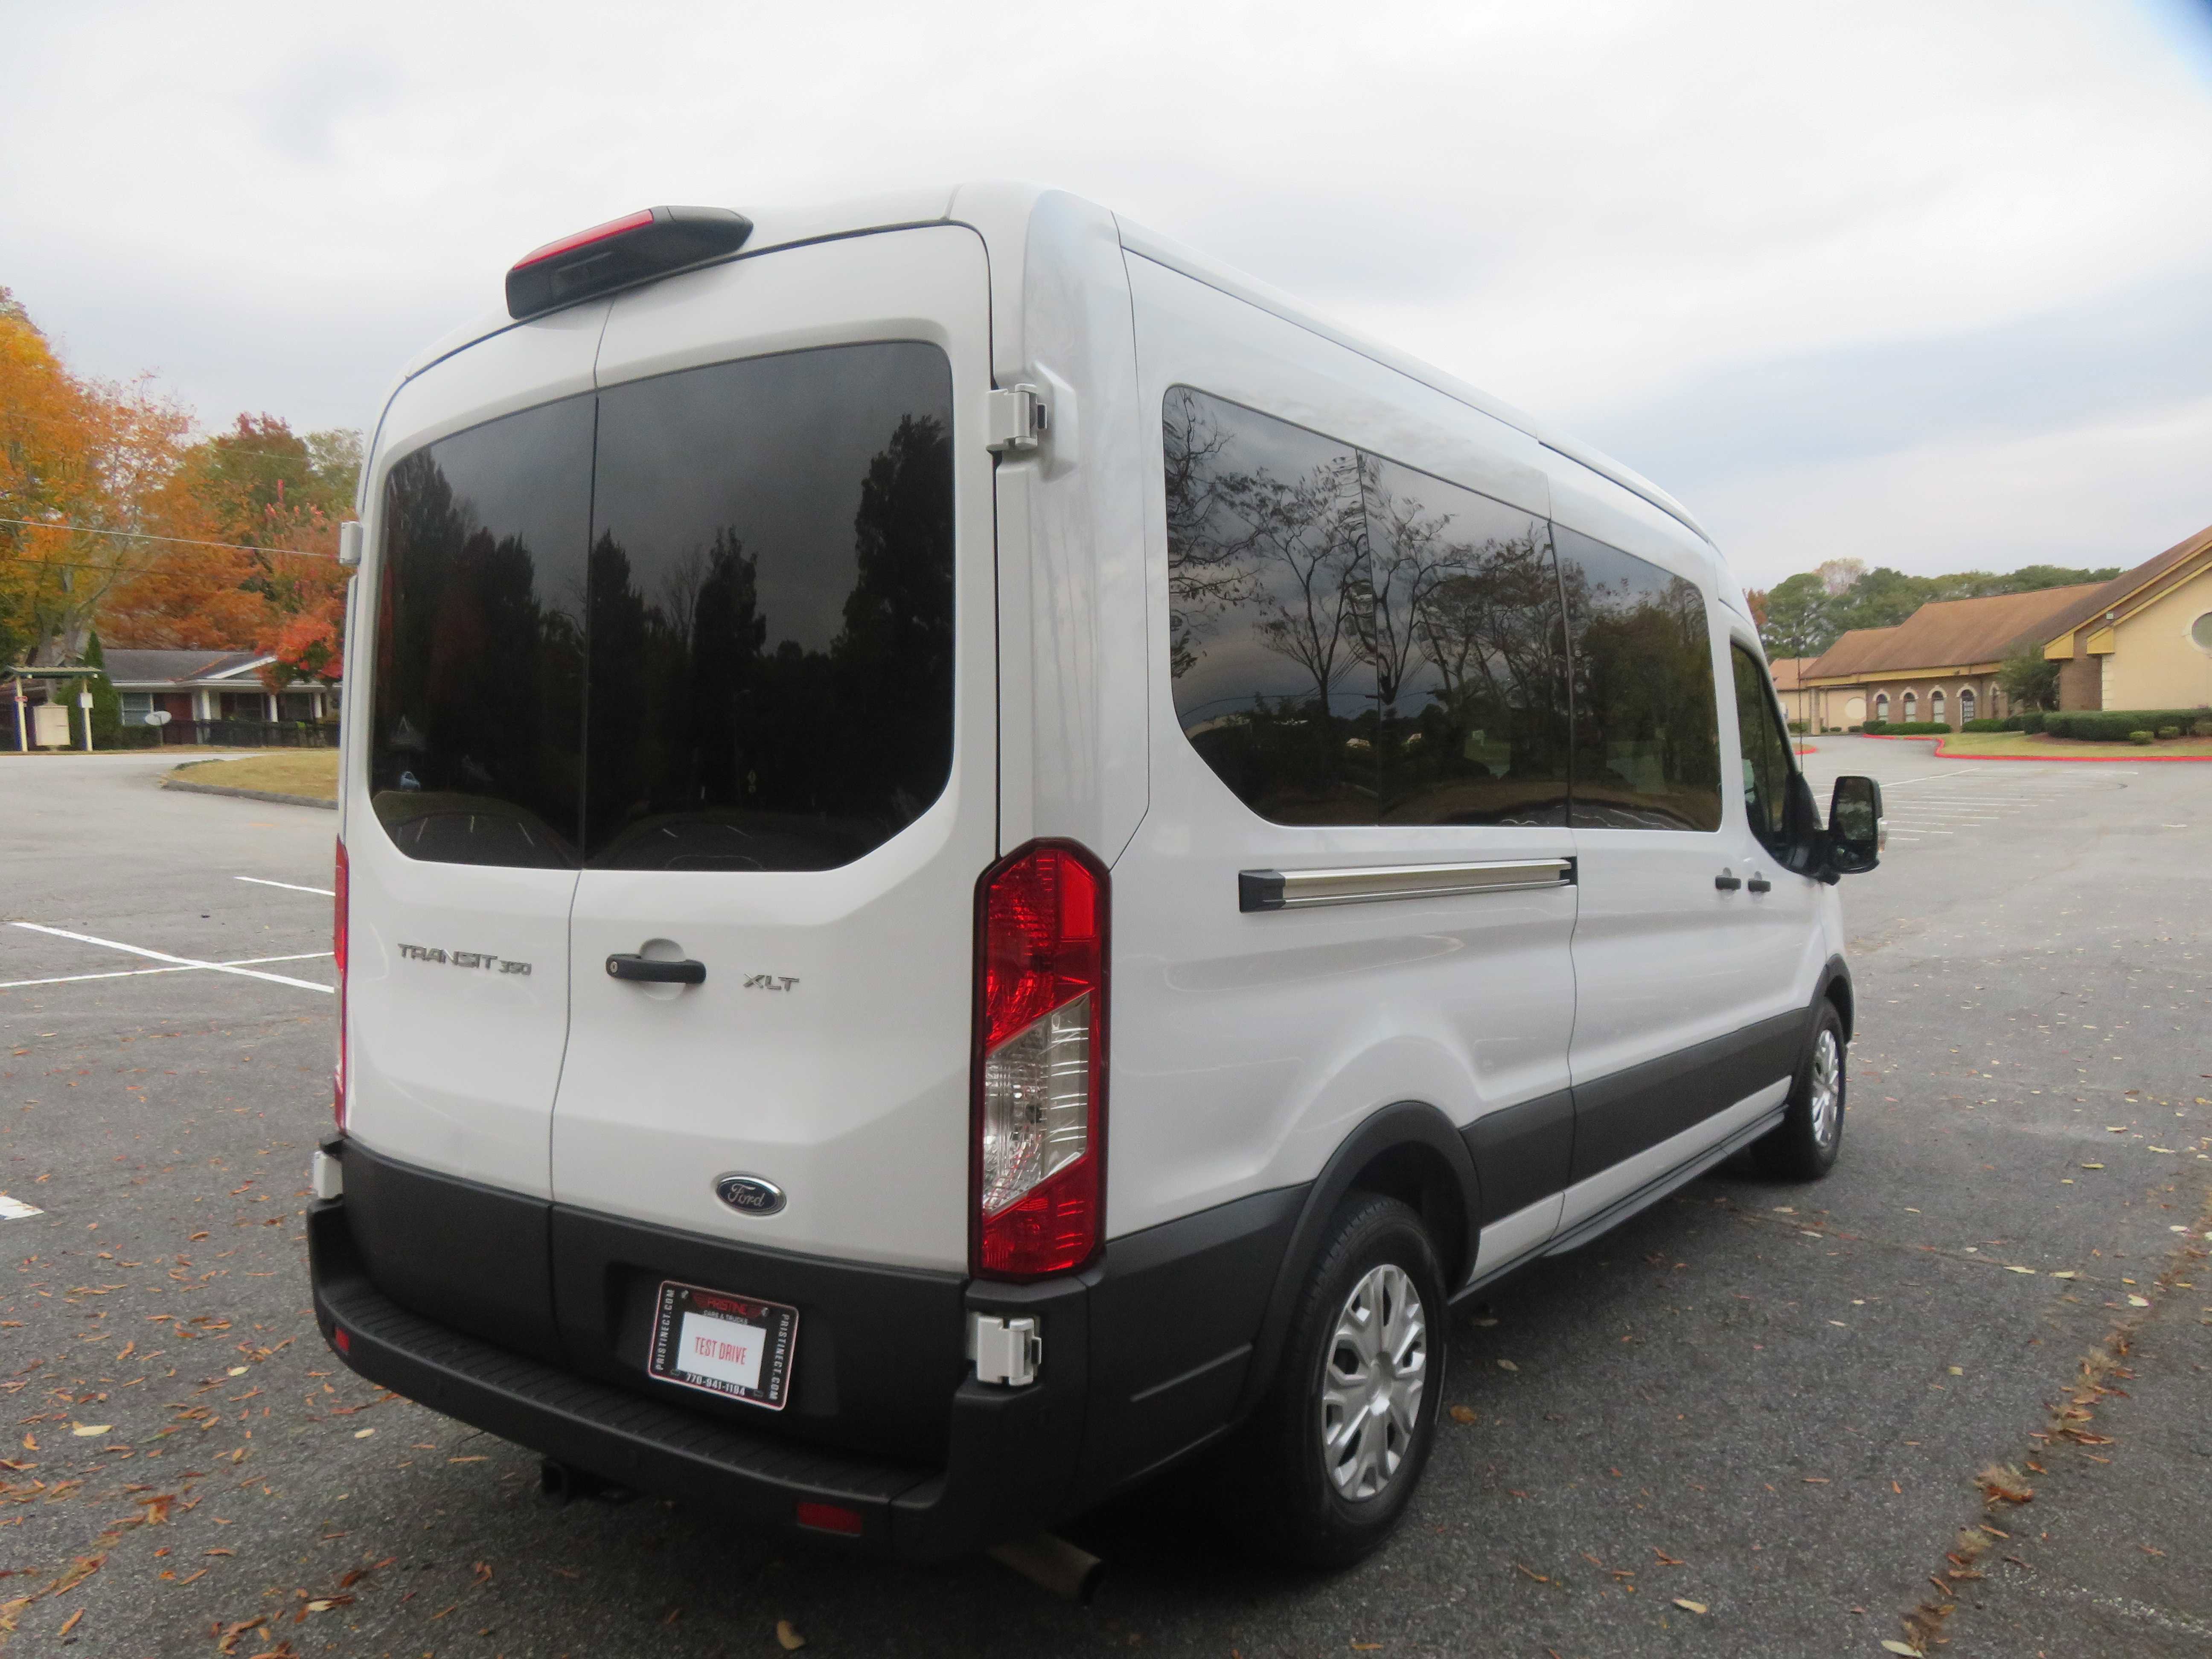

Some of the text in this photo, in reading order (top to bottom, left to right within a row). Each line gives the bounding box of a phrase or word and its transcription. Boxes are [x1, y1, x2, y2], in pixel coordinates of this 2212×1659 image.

[397, 943, 532, 976] TRANSIT 350
[743, 973, 800, 991] XLT
[728, 1183, 765, 1207] Ford
[695, 1336, 748, 1365] TEST DRIVE
[768, 1314, 790, 1400] PRISTINECT.COM
